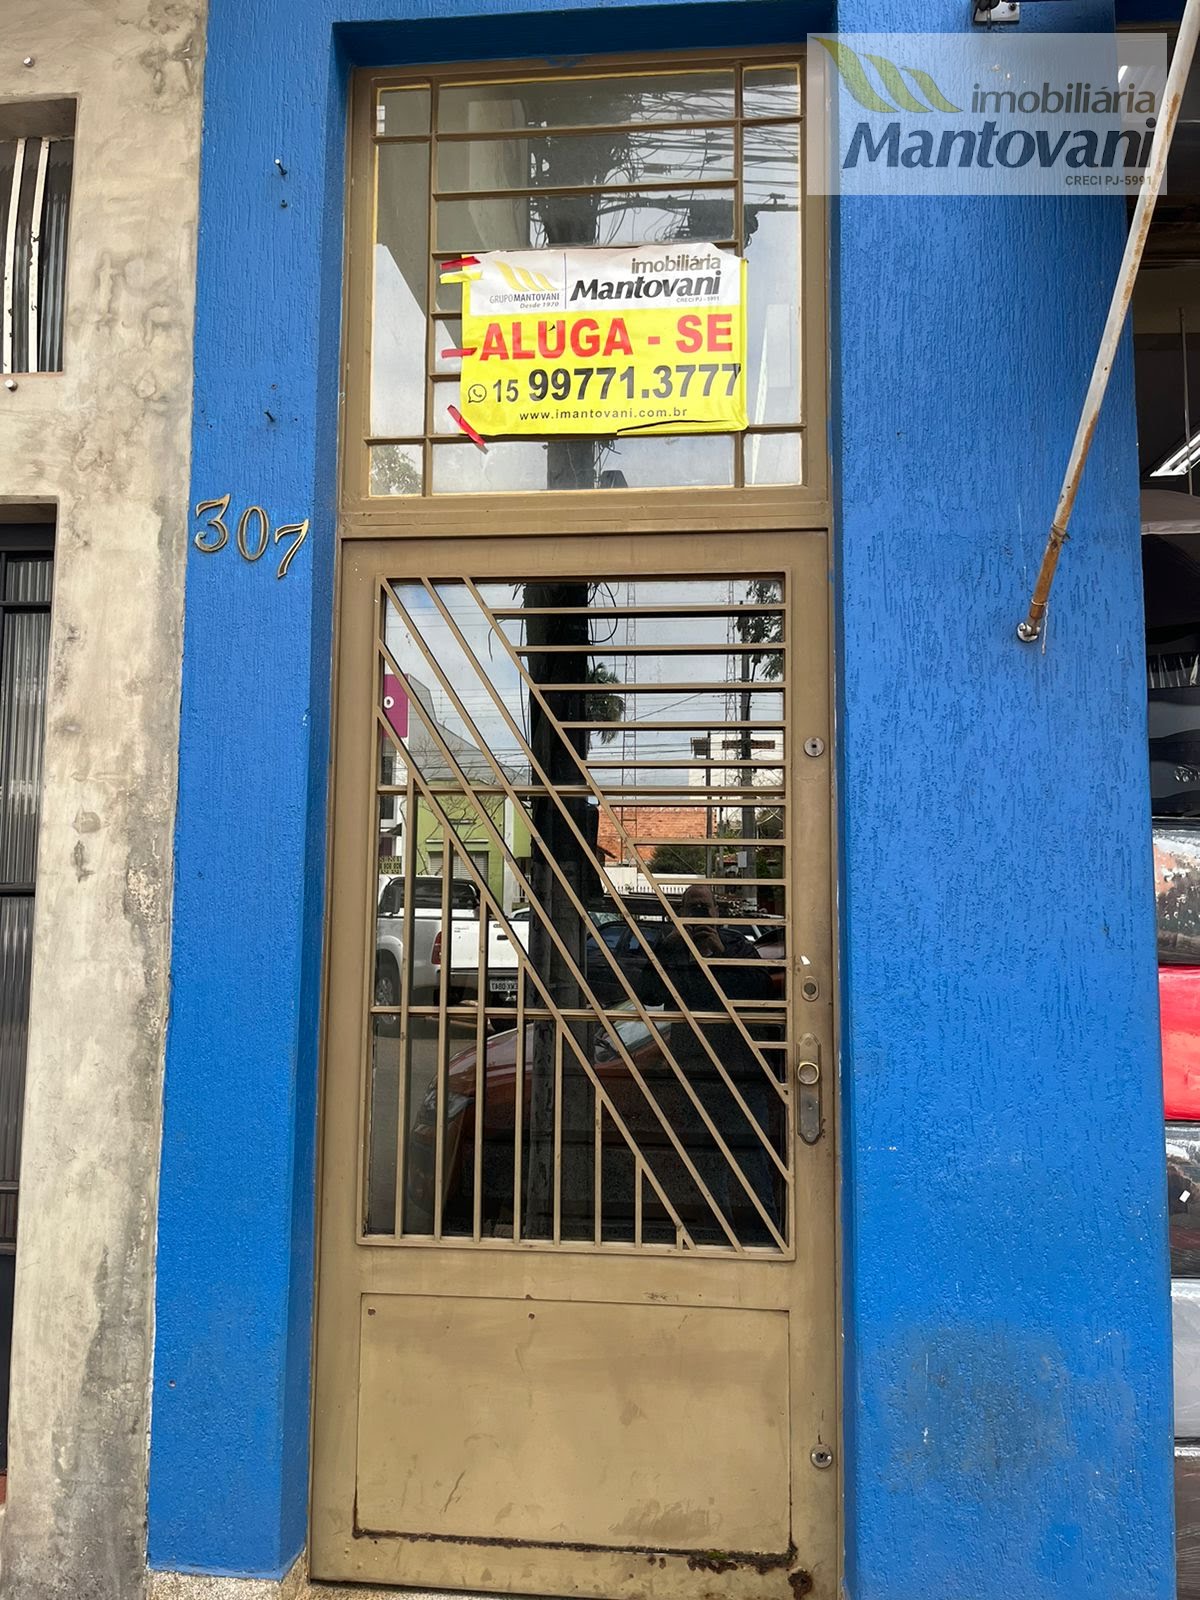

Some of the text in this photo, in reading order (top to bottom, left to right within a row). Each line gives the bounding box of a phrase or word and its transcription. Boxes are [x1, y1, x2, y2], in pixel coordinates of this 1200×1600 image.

[631, 253, 721, 274] imobiliária
[569, 270, 722, 302] Mantovani
[479, 317, 633, 361] ALUGA
[675, 313, 733, 354] SE
[492, 362, 742, 403] 15 99771.3777
[519, 406, 688, 421] www.imantovani.com.br
[194, 493, 310, 579] 307
